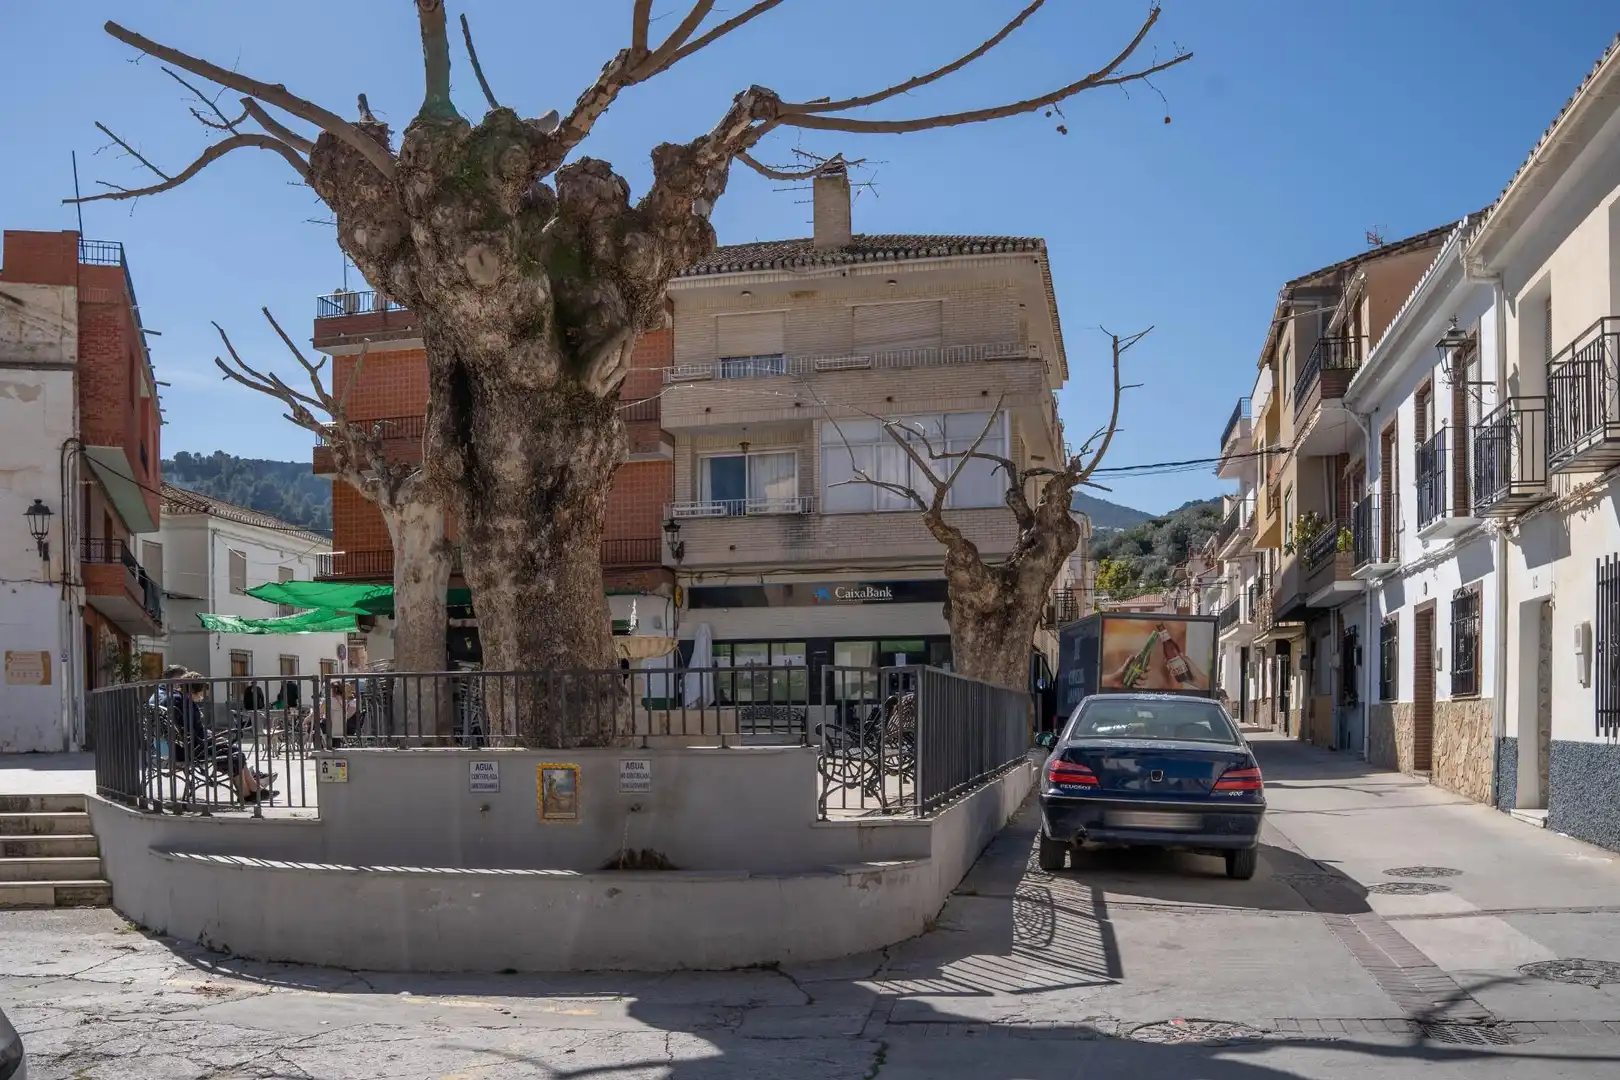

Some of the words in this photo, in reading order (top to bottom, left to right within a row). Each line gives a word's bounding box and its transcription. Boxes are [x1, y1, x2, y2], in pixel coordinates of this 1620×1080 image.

[834, 586, 893, 599] CaixaBank
[475, 763, 494, 772] AGUA
[625, 761, 645, 770] AGUA
